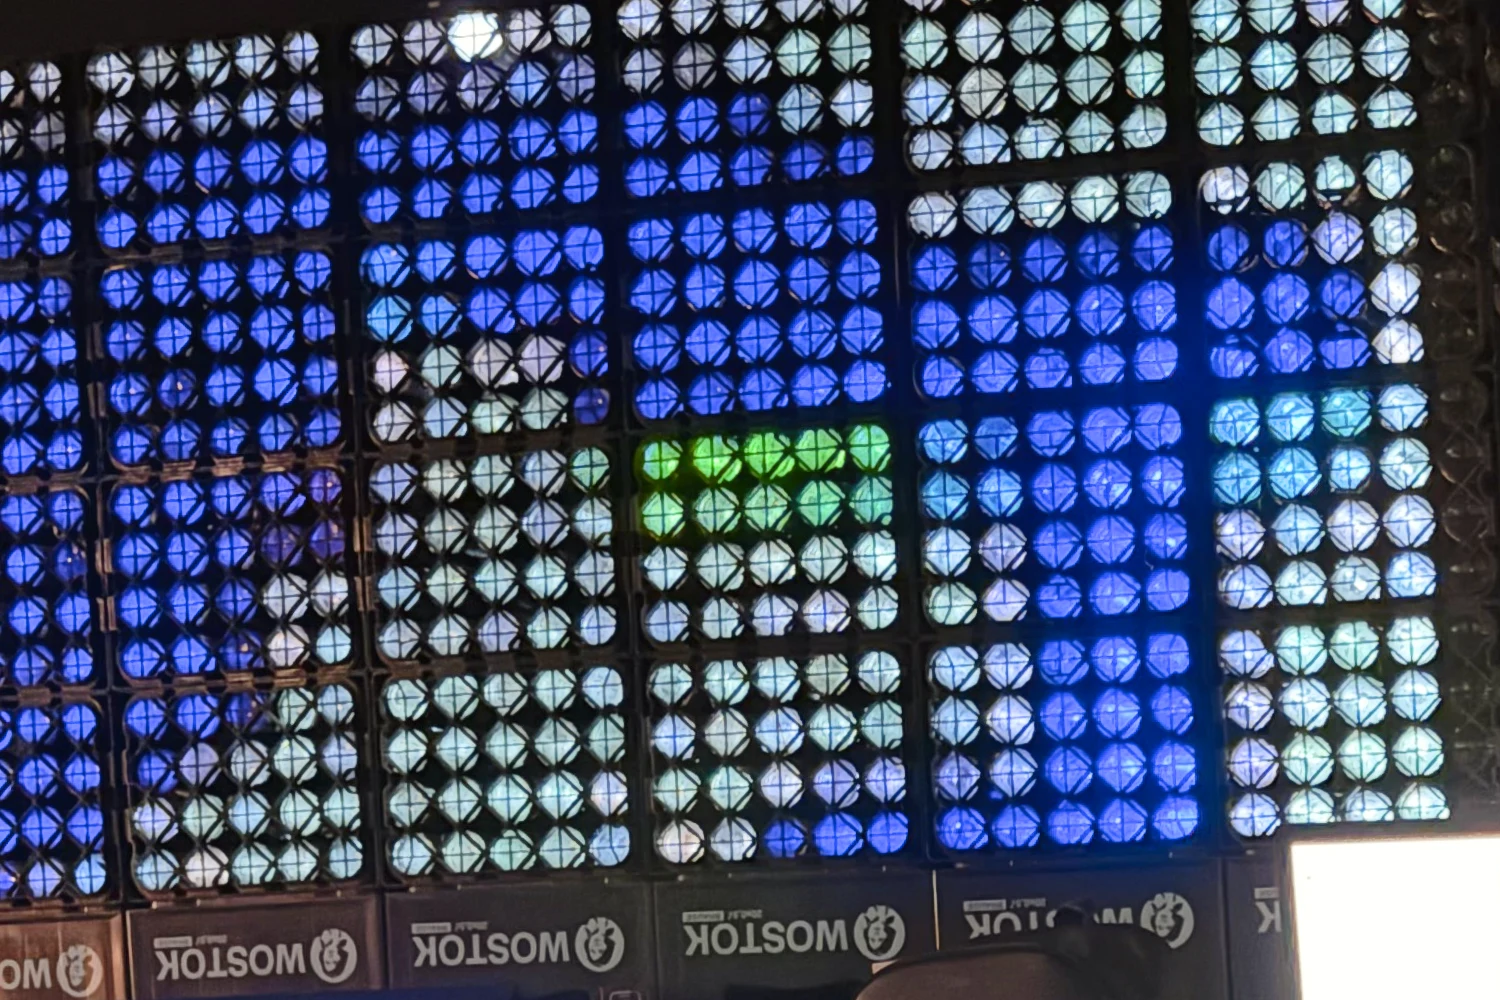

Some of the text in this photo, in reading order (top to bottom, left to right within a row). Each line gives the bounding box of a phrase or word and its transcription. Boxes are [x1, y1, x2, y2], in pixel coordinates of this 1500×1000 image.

[412, 931, 570, 967] WOSTOK
[683, 919, 849, 955] WOSTOK
[0, 958, 52, 990] WO
[155, 943, 306, 981] WOSTOK
